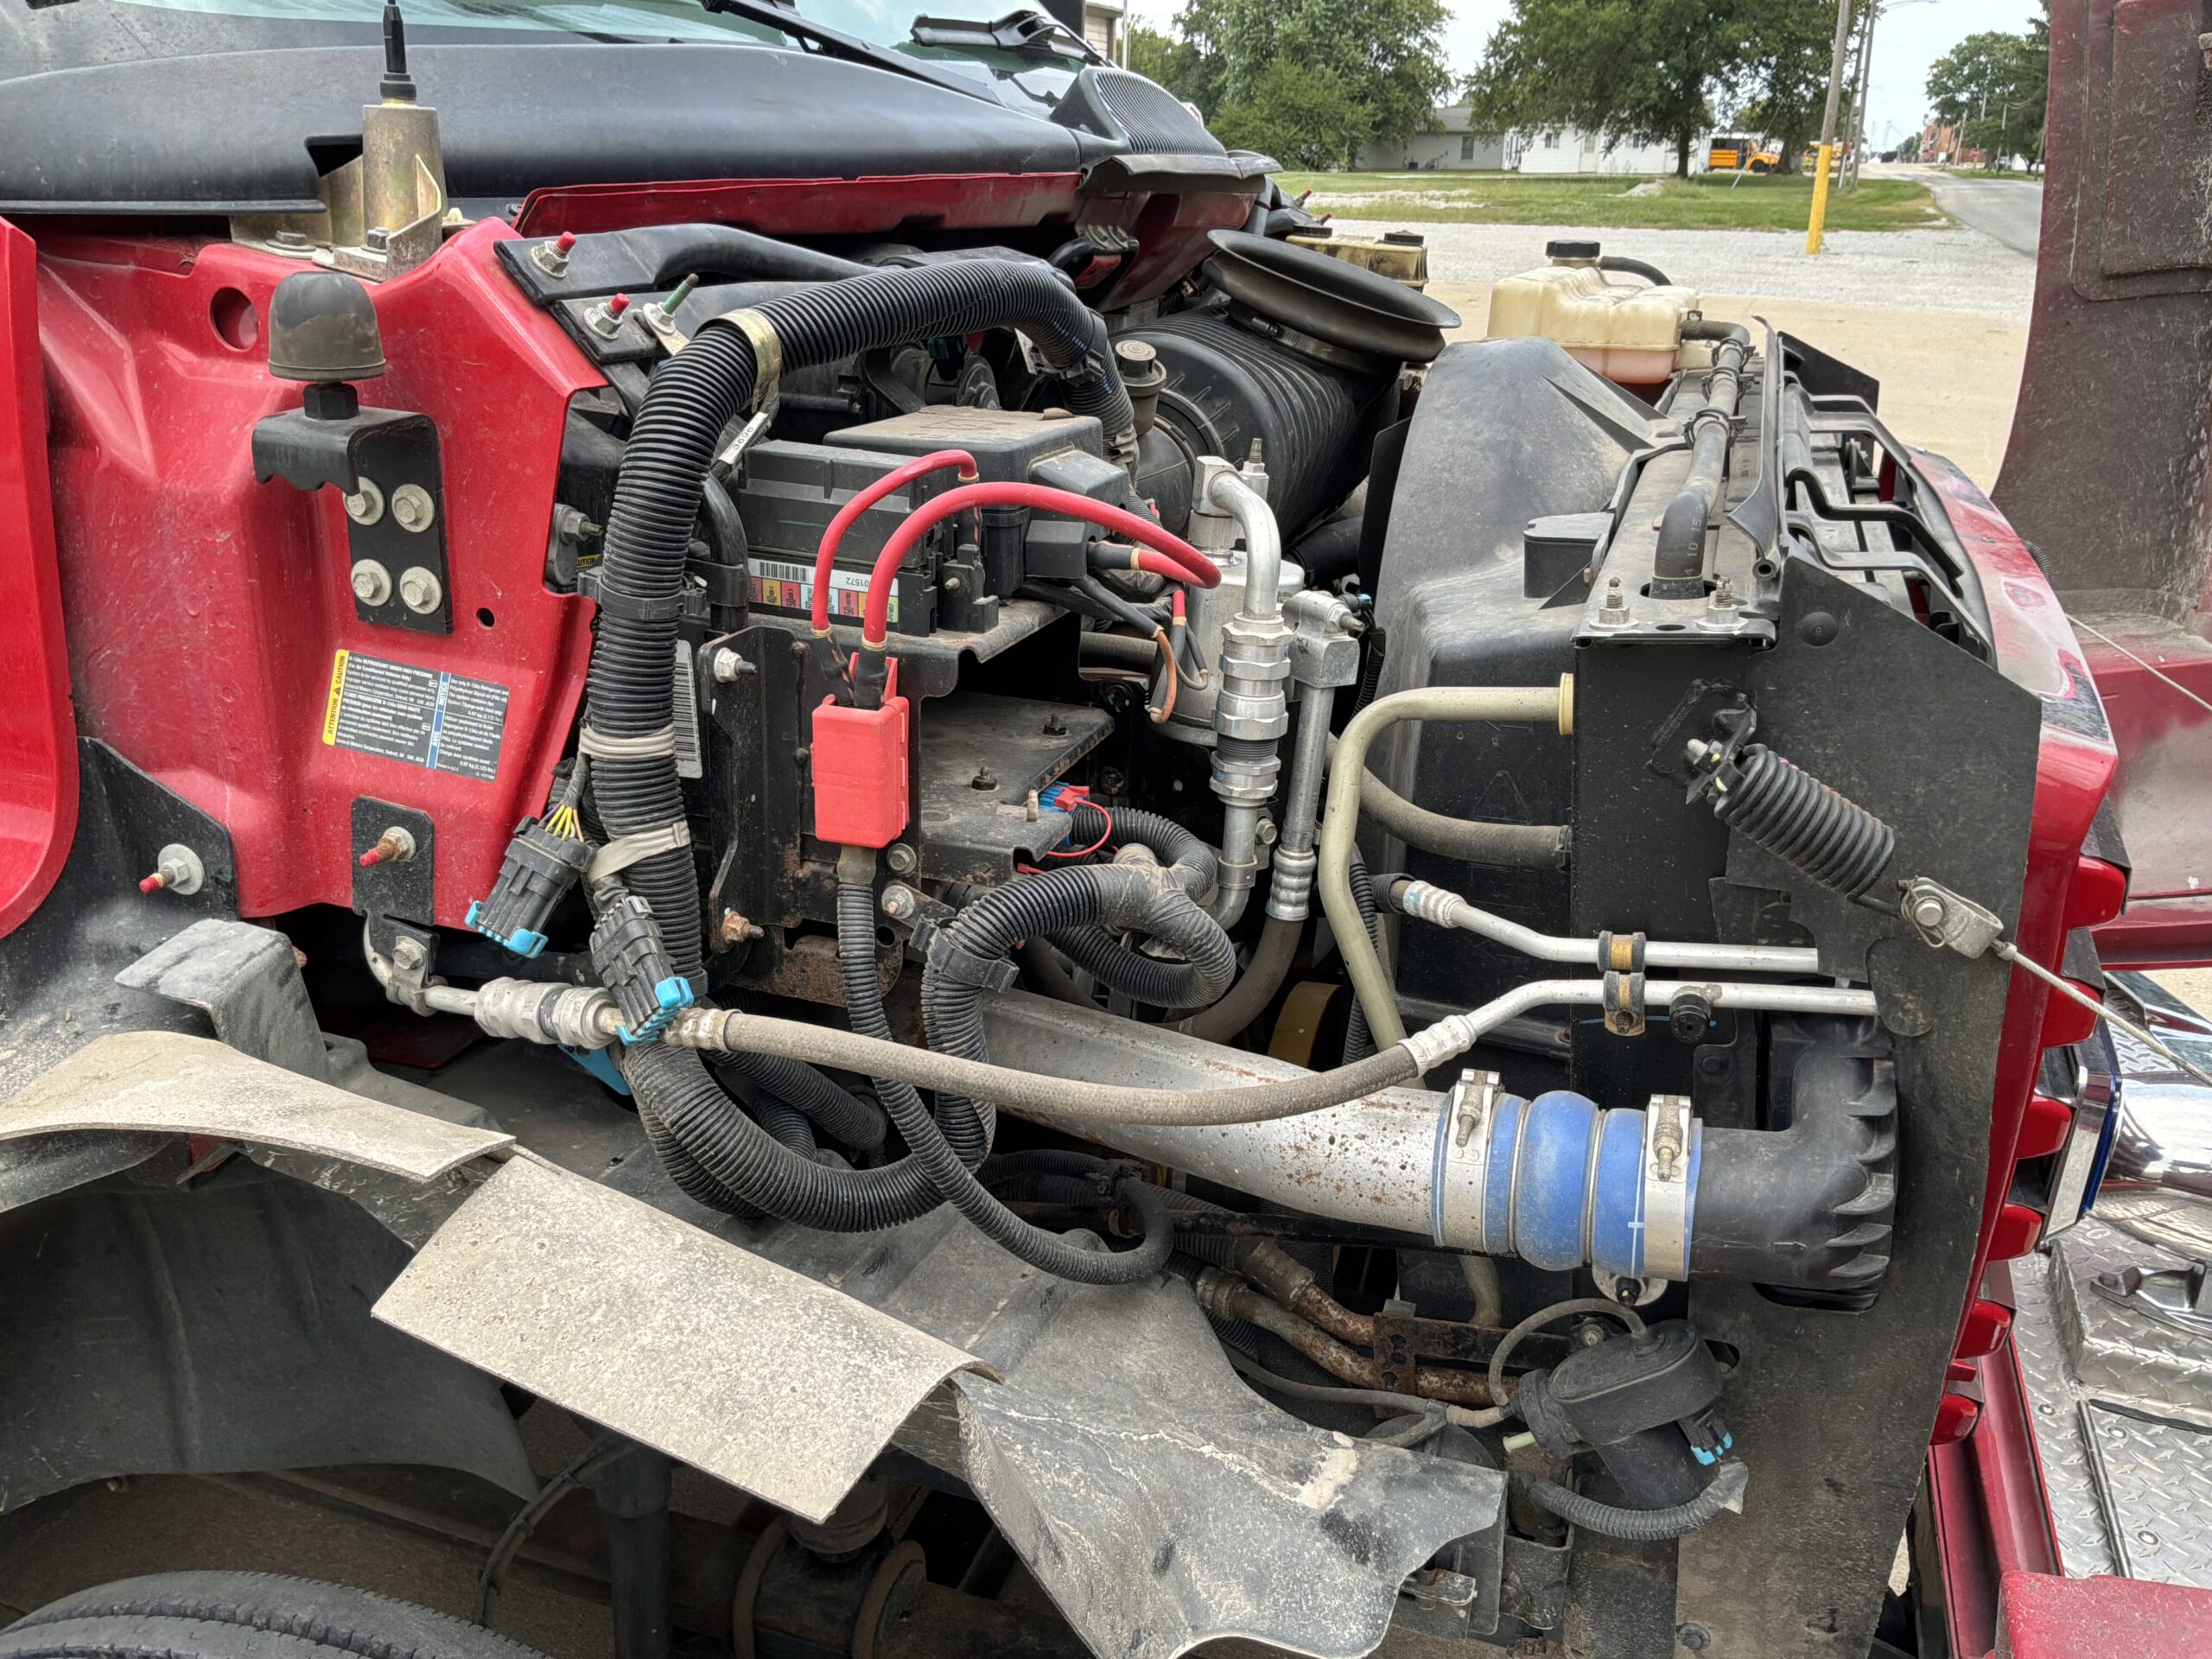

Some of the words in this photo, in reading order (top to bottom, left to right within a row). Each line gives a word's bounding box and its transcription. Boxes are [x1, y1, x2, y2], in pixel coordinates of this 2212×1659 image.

[733, 427, 754, 450] 3696
[1687, 543, 1698, 556] 10
[335, 655, 346, 684] CAUTION
[438, 681, 448, 705] NOTICE
[327, 697, 339, 734] ATTENTION
